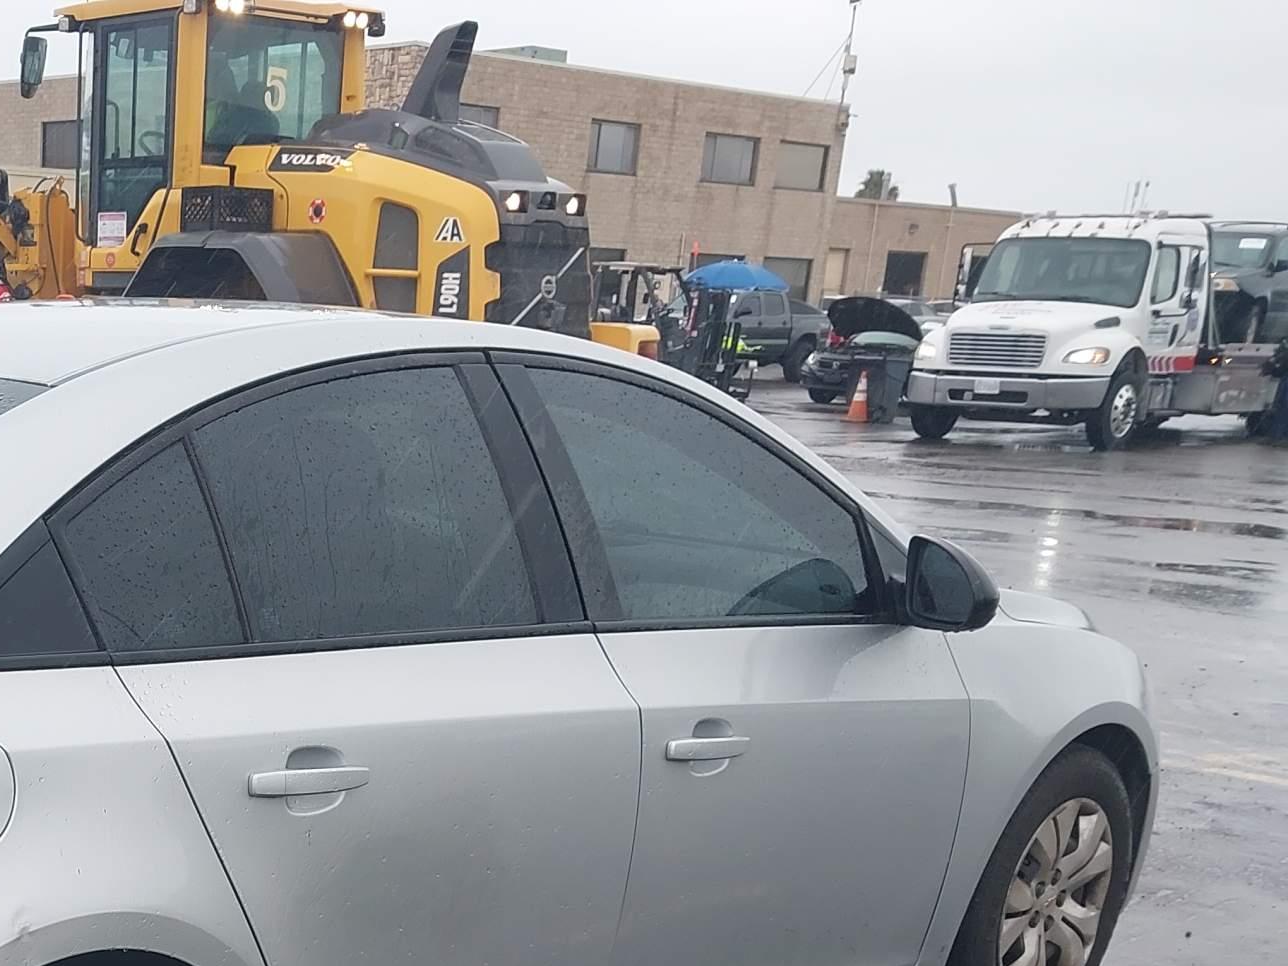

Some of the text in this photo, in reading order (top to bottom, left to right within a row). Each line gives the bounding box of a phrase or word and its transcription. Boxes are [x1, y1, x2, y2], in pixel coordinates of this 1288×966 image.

[264, 66, 288, 112] 5
[280, 153, 342, 166] VOLVO
[438, 272, 462, 313] L90H
